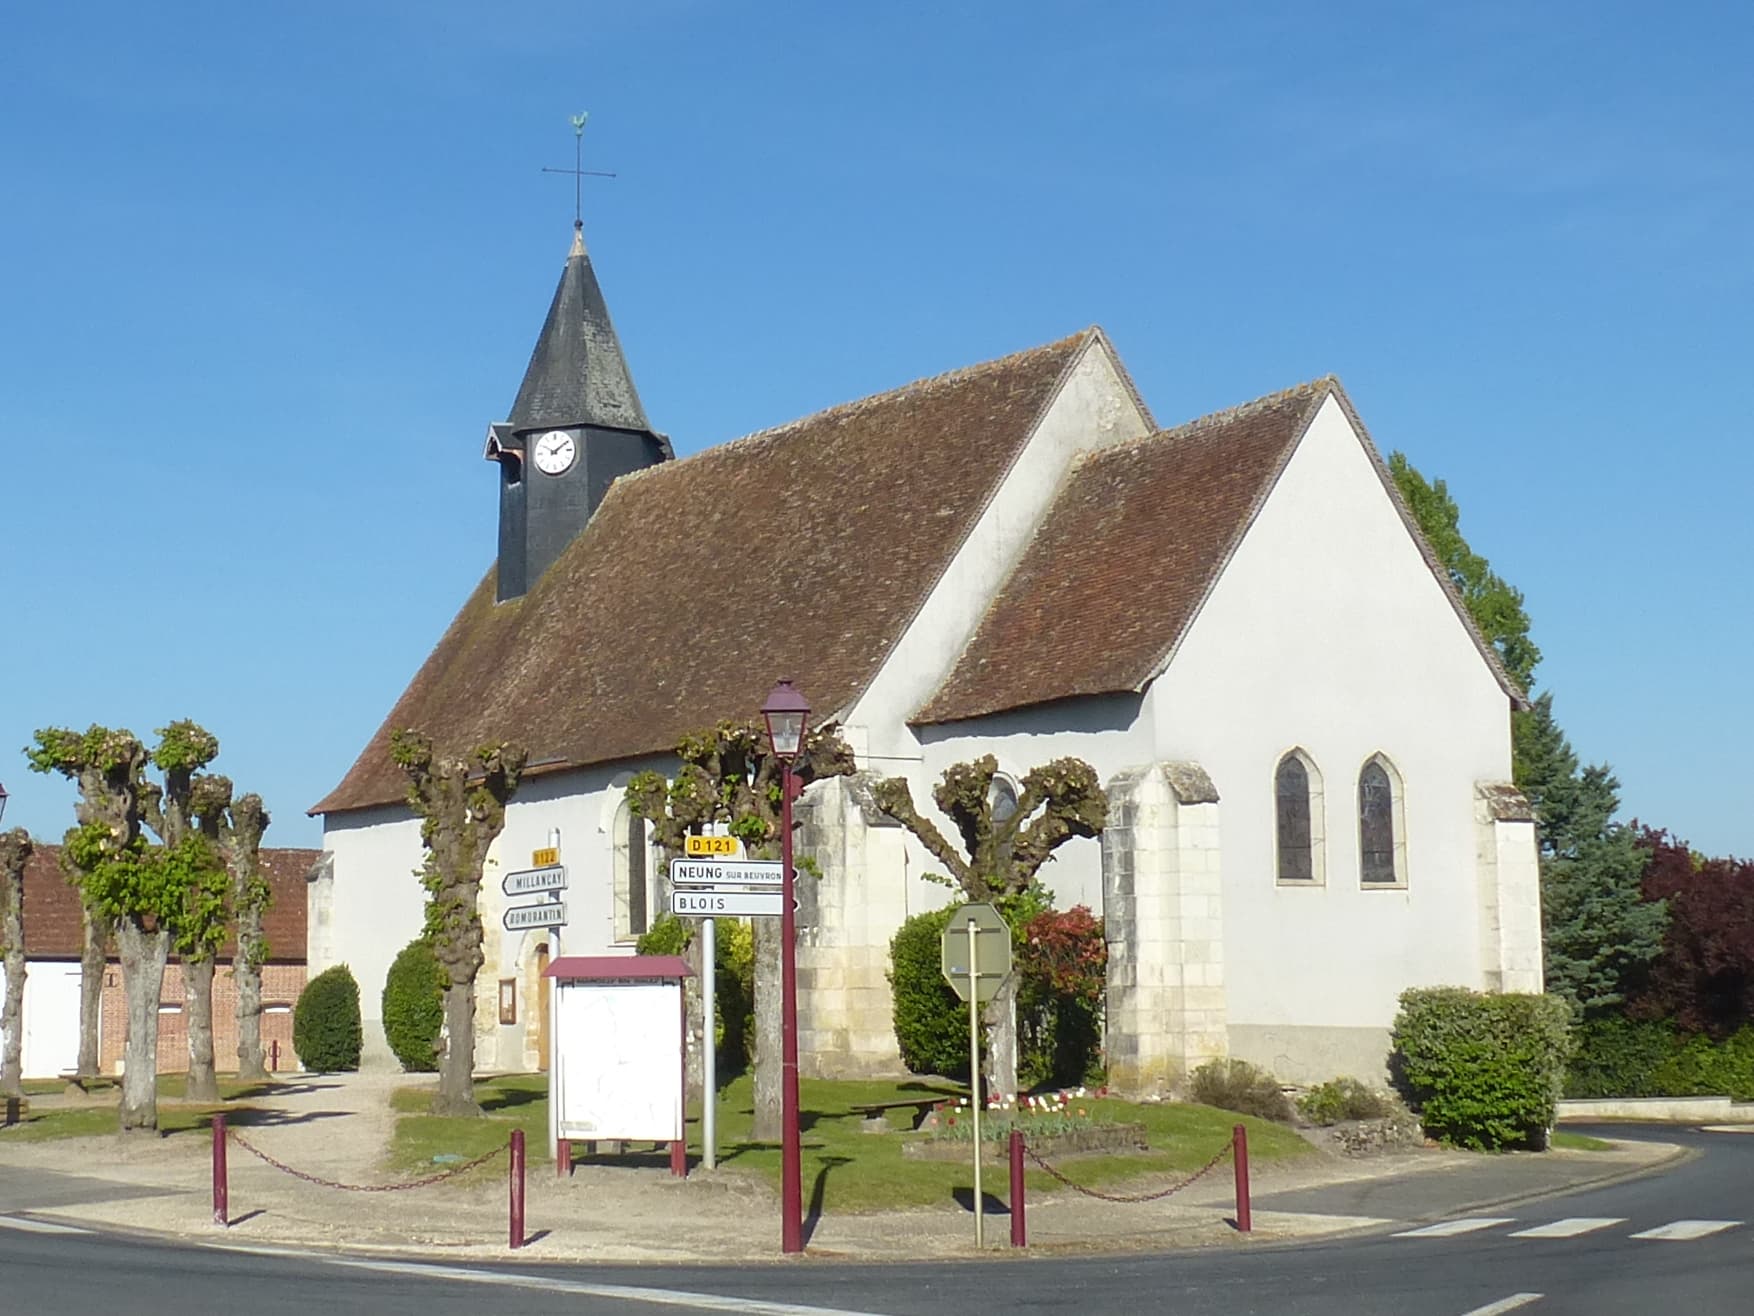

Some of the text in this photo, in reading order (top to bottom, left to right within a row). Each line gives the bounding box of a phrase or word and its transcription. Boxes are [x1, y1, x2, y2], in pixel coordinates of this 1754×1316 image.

[679, 867, 723, 879] NEUNG
[743, 872, 782, 880] BEUVRON
[679, 898, 726, 910] BLOIS
